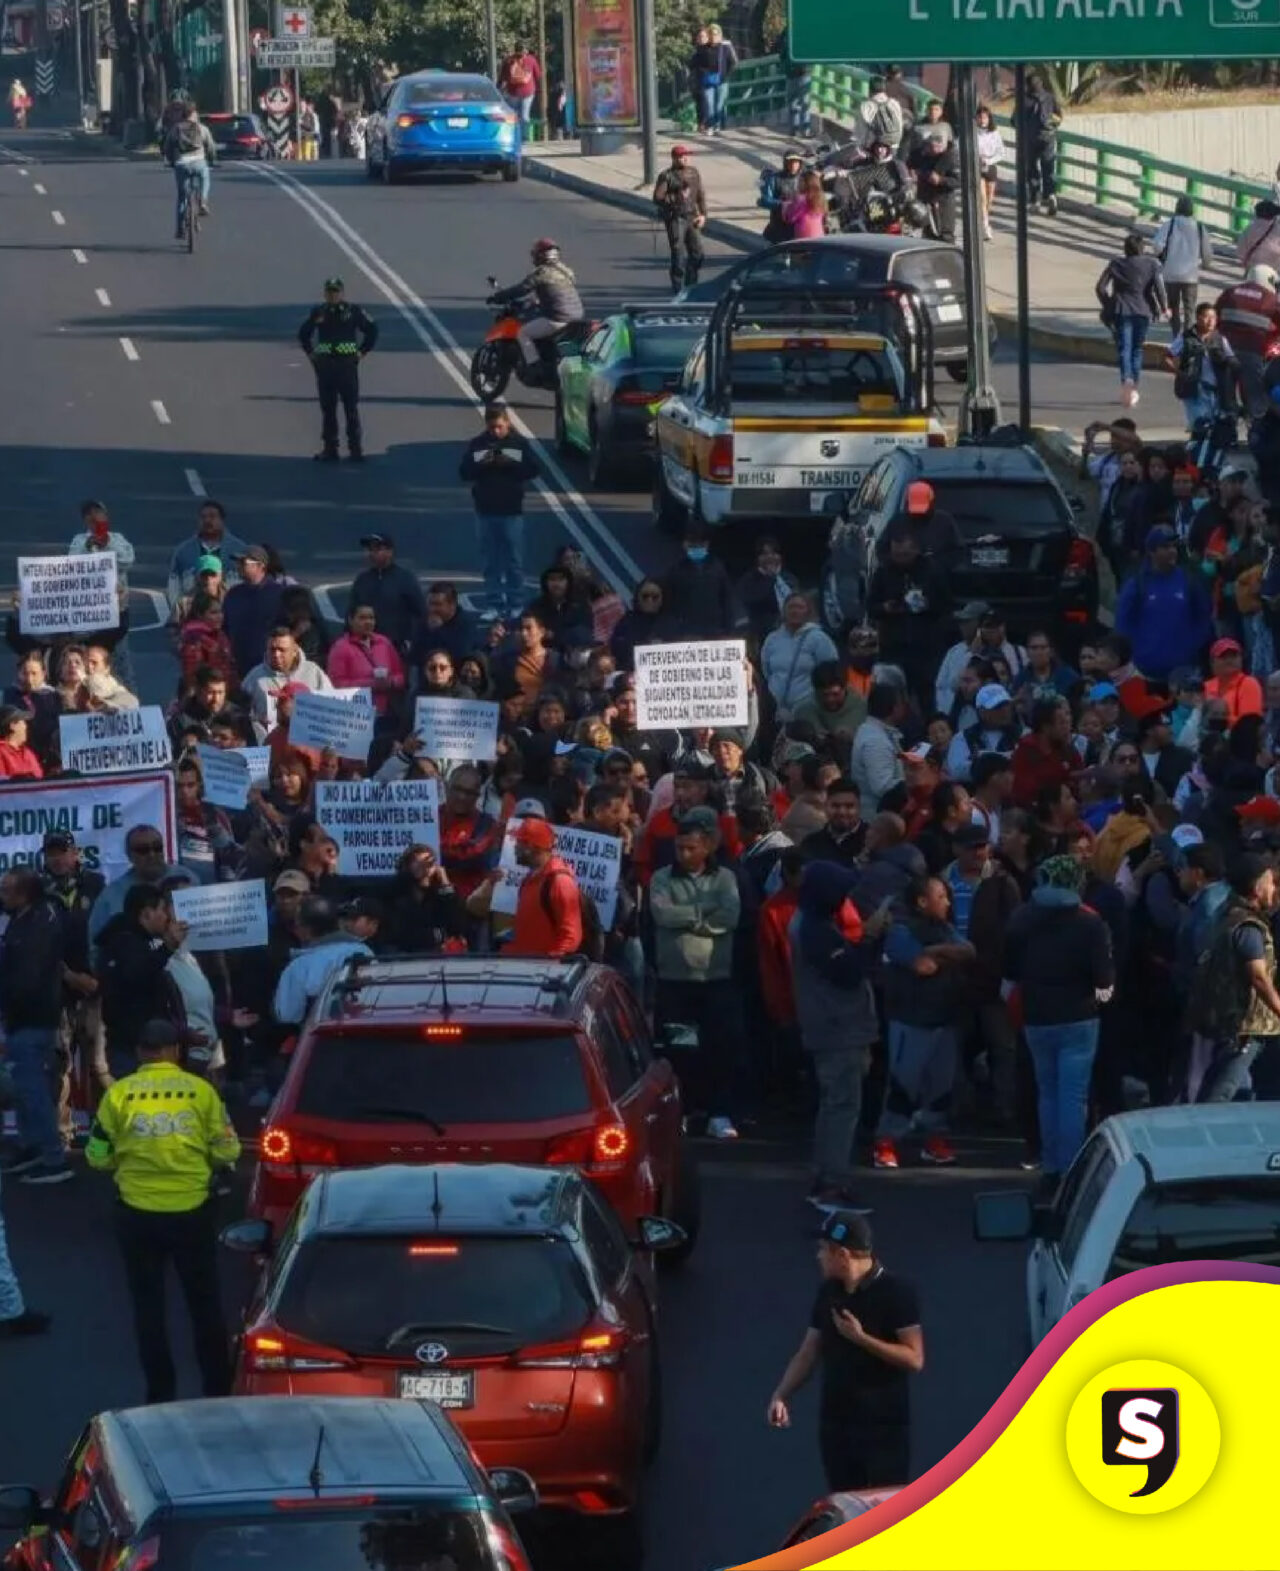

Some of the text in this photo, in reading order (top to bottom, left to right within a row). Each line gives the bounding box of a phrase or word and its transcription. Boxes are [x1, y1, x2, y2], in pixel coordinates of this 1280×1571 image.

[1233, 11, 1258, 21] SUR
[87, 561, 96, 573] LA
[81, 577, 90, 589] EN
[93, 575, 106, 589] LAS
[639, 645, 741, 665] INTERVENCIÓN DE LA JEFA
[650, 666, 732, 683] DE GOBIERNO EN LAS
[645, 686, 691, 702] SIGUIENTES
[693, 703, 737, 719] IZTACALCO
[86, 711, 144, 740] PEDIMOS LA
[141, 740, 154, 764] DE
[156, 740, 168, 762] LA
[341, 785, 348, 802] A
[351, 785, 361, 803] LA
[364, 785, 393, 802] LIMPIA
[395, 783, 429, 802] SOCIAL
[92, 803, 123, 829] DE
[321, 805, 434, 824] DE COMERCIANTES EN EL
[344, 830, 413, 847] PARQUE DE LOS
[574, 838, 587, 855] DE
[588, 840, 599, 856] LA
[576, 860, 588, 877] EN
[590, 862, 607, 880] LAS
[133, 1110, 197, 1137] SSC
